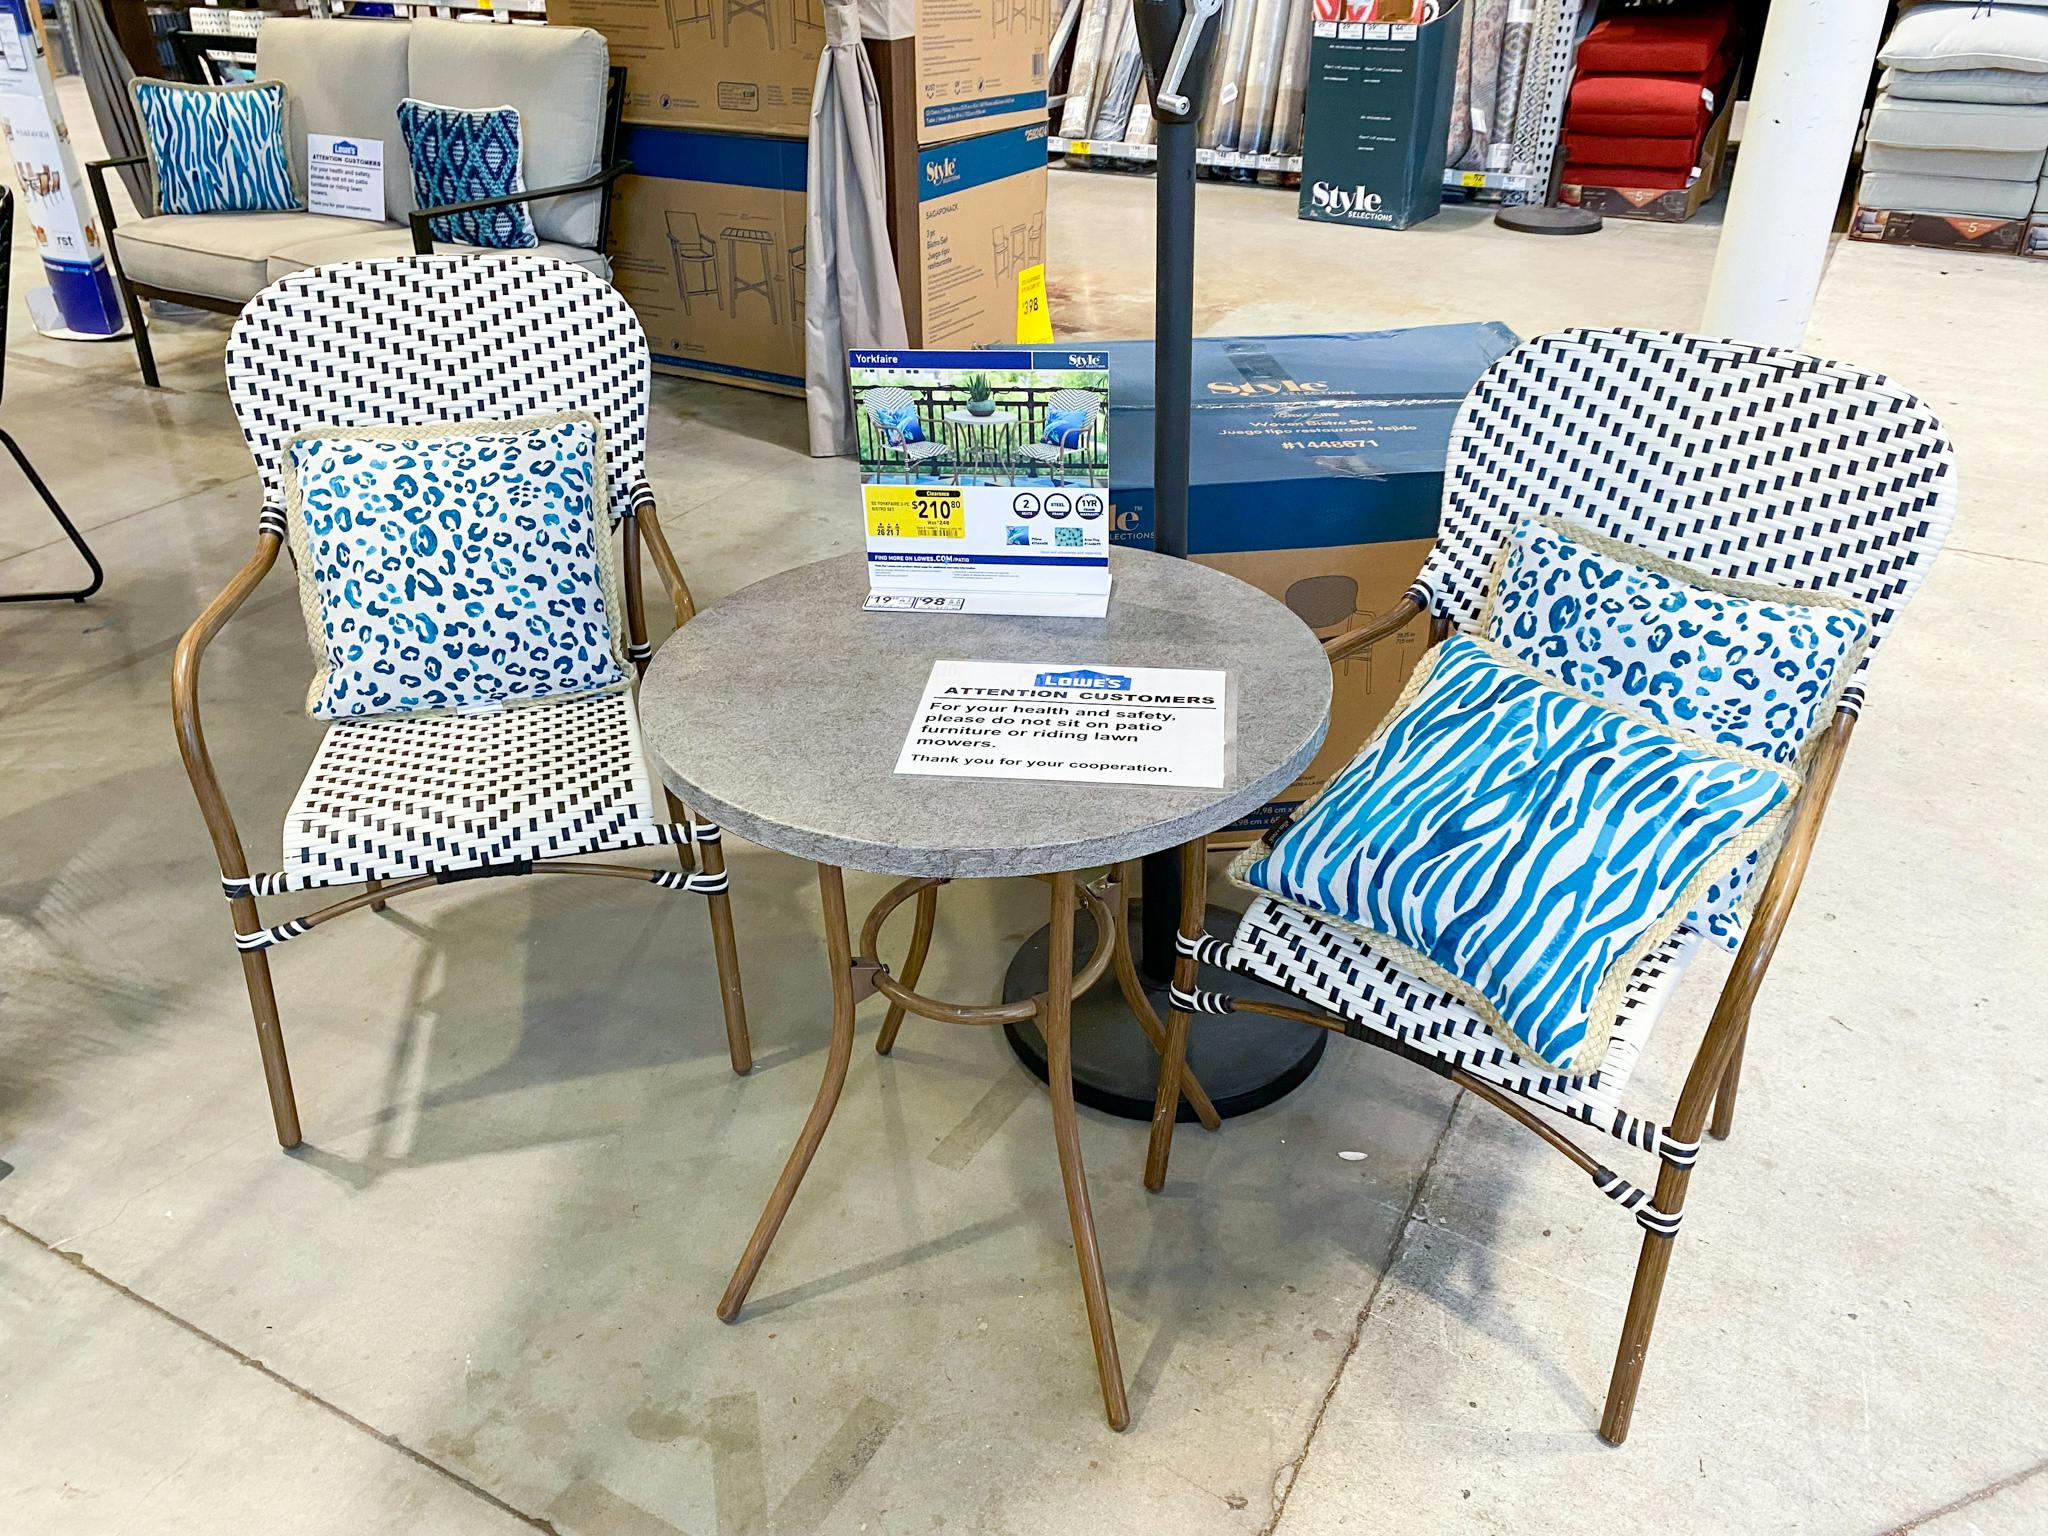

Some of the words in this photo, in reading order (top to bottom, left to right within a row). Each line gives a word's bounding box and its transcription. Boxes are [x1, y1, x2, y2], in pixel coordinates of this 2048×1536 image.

[335, 145, 356, 155] LOWE'S
[313, 154, 342, 162] ATTENTION
[345, 158, 381, 167] CUSTOMERS
[926, 158, 956, 186] Style
[1312, 181, 1383, 216] Style
[1636, 192, 1643, 201] 5
[1348, 211, 1393, 222] SELECTIONS
[1968, 223, 1978, 233] 5
[57, 235, 74, 247] rst
[856, 354, 898, 364] Yorkfaire
[1069, 354, 1101, 369] Style
[1207, 380, 1329, 397] Style
[1265, 428, 1293, 436] tipo
[1377, 424, 1418, 432] tejido
[1281, 440, 1379, 450] #1448671
[911, 500, 951, 519] $210
[951, 501, 961, 509] 80
[1023, 500, 1030, 509] 2
[1110, 532, 1155, 541] LECTIONS
[1044, 675, 1121, 689] LOWE'S
[944, 687, 1068, 699] ATTENTION
[1080, 692, 1215, 705] CUSTOMERS
[930, 702, 961, 711] For
[965, 705, 1008, 714] your
[1013, 705, 1069, 716] health
[1076, 709, 1109, 717] and
[1116, 710, 1176, 722] safety,
[925, 714, 986, 723] please
[992, 716, 1015, 725] do
[1021, 717, 1052, 726] not
[1057, 720, 1081, 728] sit
[1086, 721, 1109, 729] on
[1116, 723, 1163, 732] patio
[921, 725, 1001, 736] furniture
[1008, 729, 1028, 737] or
[1033, 729, 1088, 742] riding
[1095, 732, 1138, 742] lawn
[916, 738, 996, 748] mowers.
[911, 754, 959, 763] Thank
[964, 758, 994, 766] you
[1000, 758, 1023, 766] for
[1026, 760, 1065, 768] your
[1069, 761, 1173, 773] cooperation.
